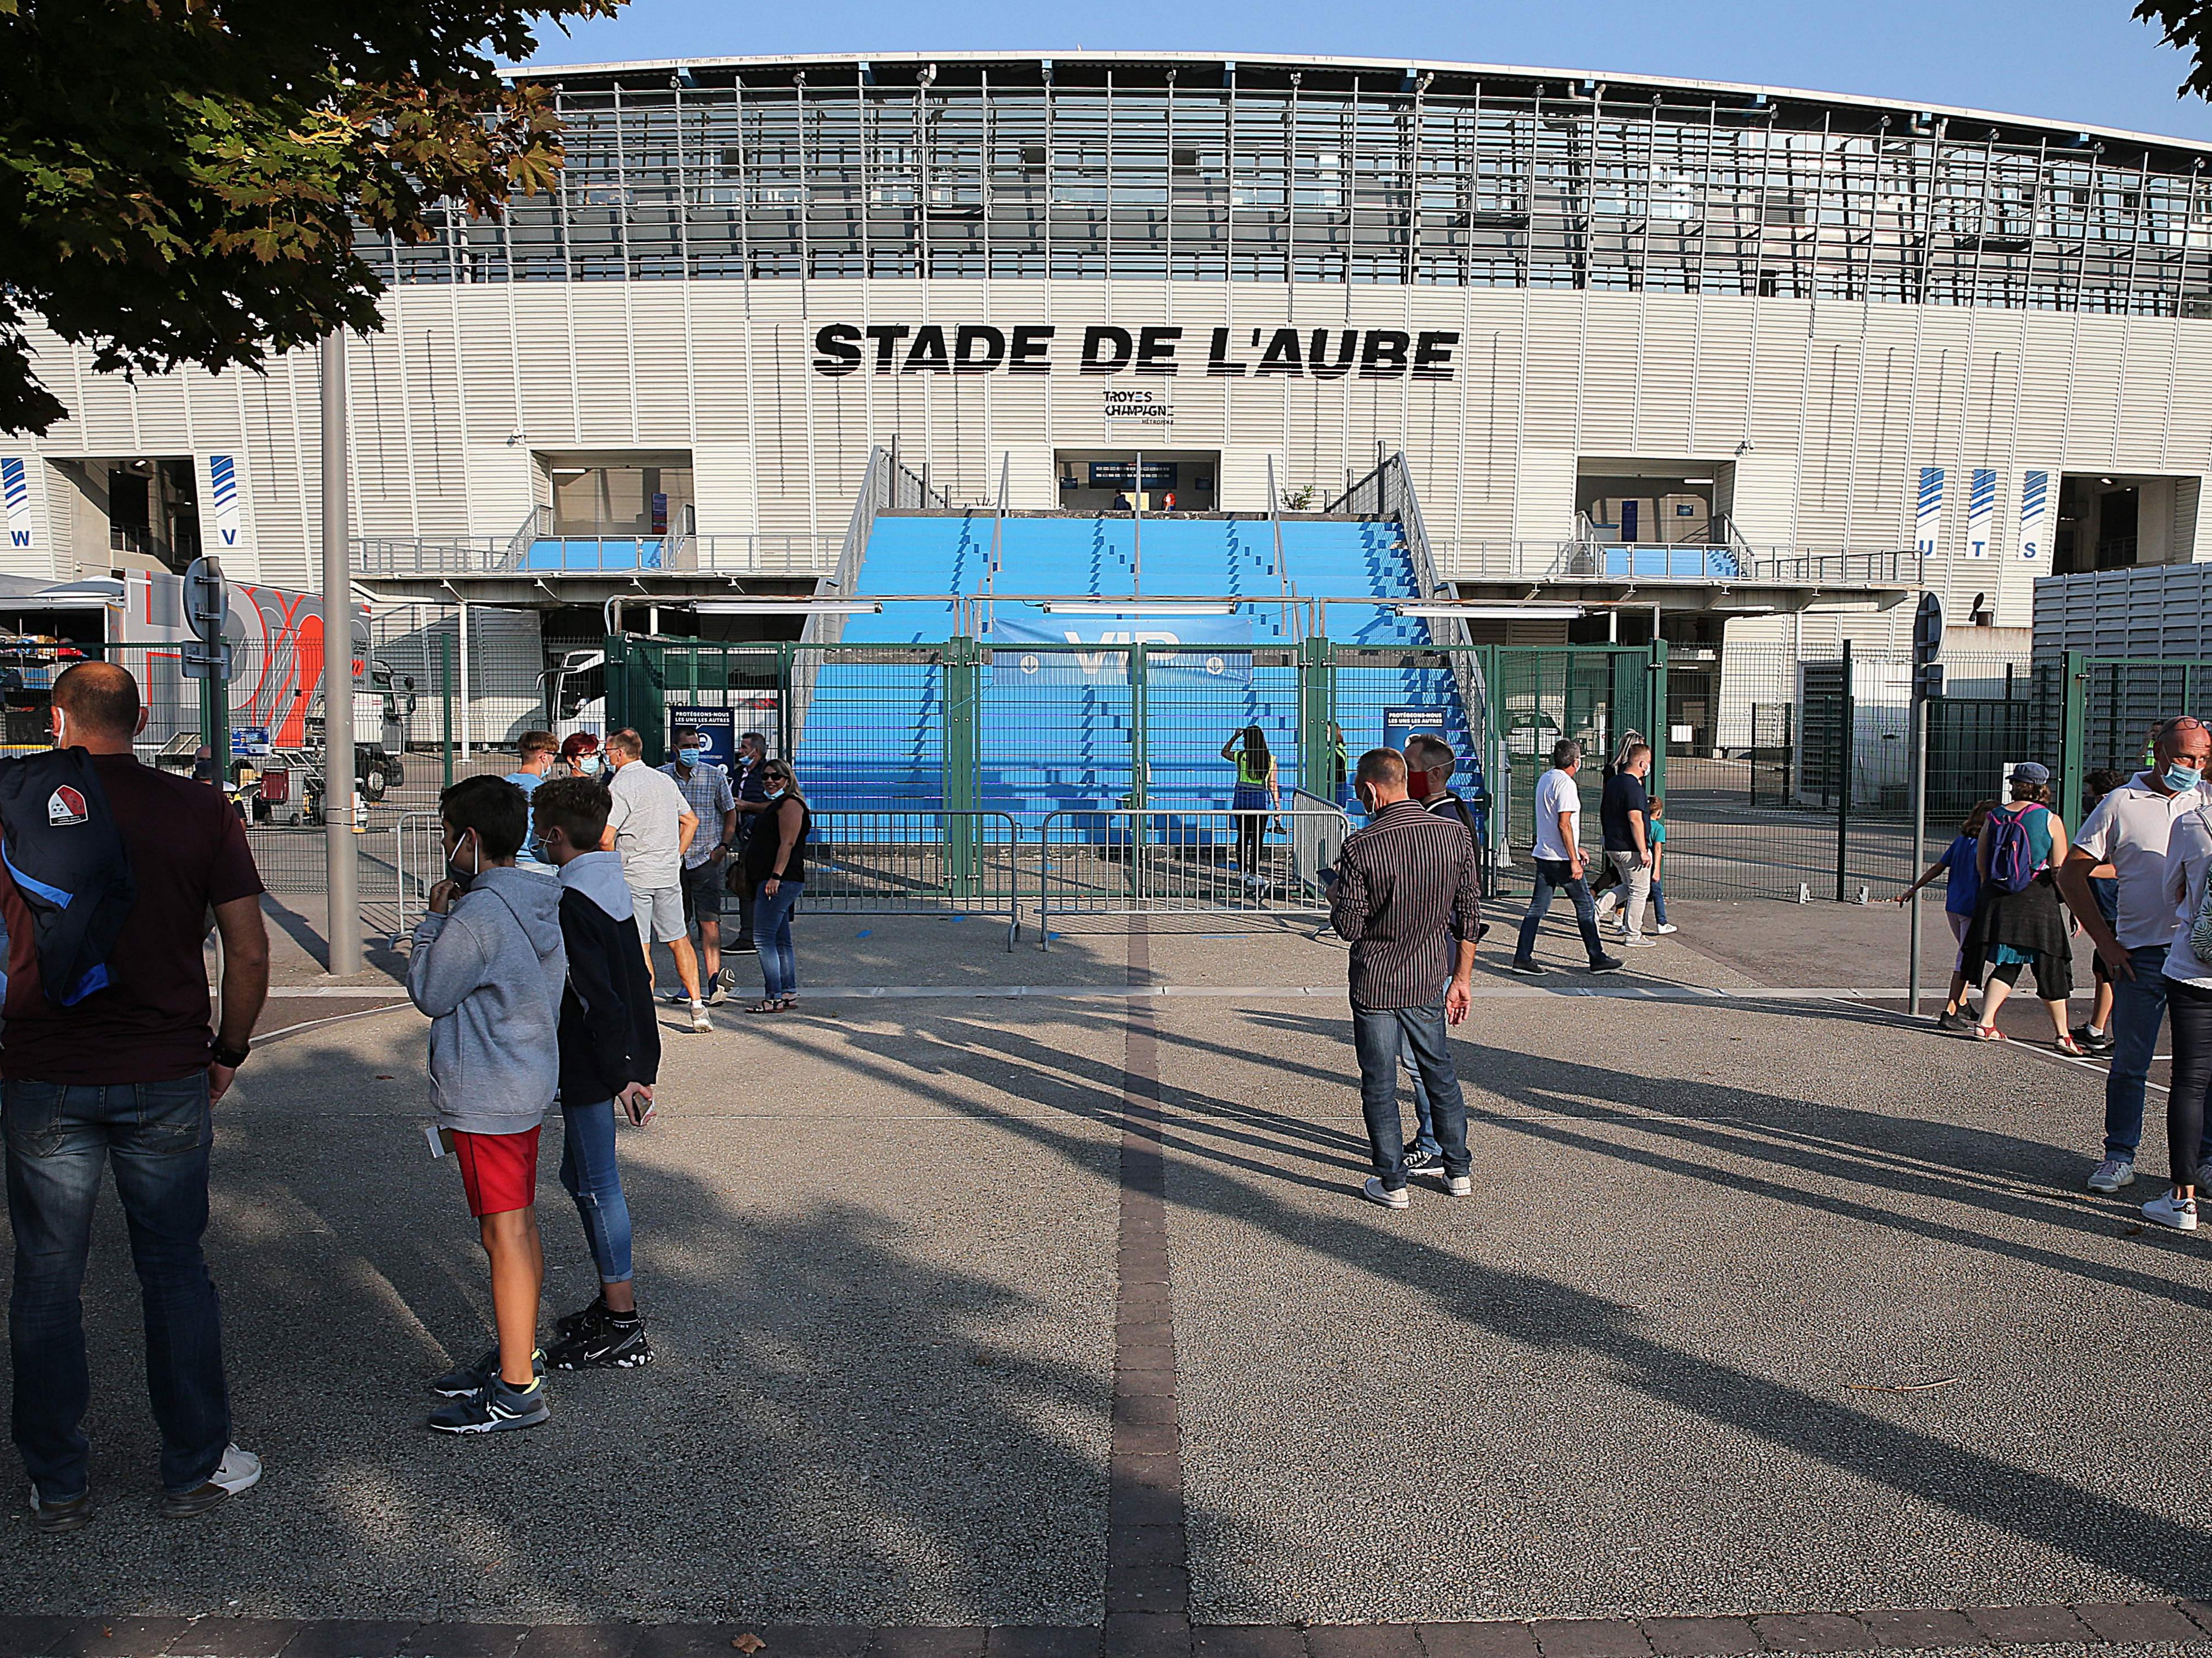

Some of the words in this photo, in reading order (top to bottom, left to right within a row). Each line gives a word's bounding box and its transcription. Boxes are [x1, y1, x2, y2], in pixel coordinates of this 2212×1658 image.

[813, 323, 1055, 377] STADE
[1080, 325, 1182, 377] DE
[1207, 327, 1460, 381] L'AUBE
[1103, 391, 1152, 402] TROYES
[1105, 405, 1174, 416] CHAMPAGNE
[11, 531, 29, 546] W
[221, 529, 236, 545] V
[1919, 540, 1933, 555] U
[1972, 541, 1985, 557] T
[2023, 542, 2036, 558] S
[1063, 631, 1181, 675] VIP
